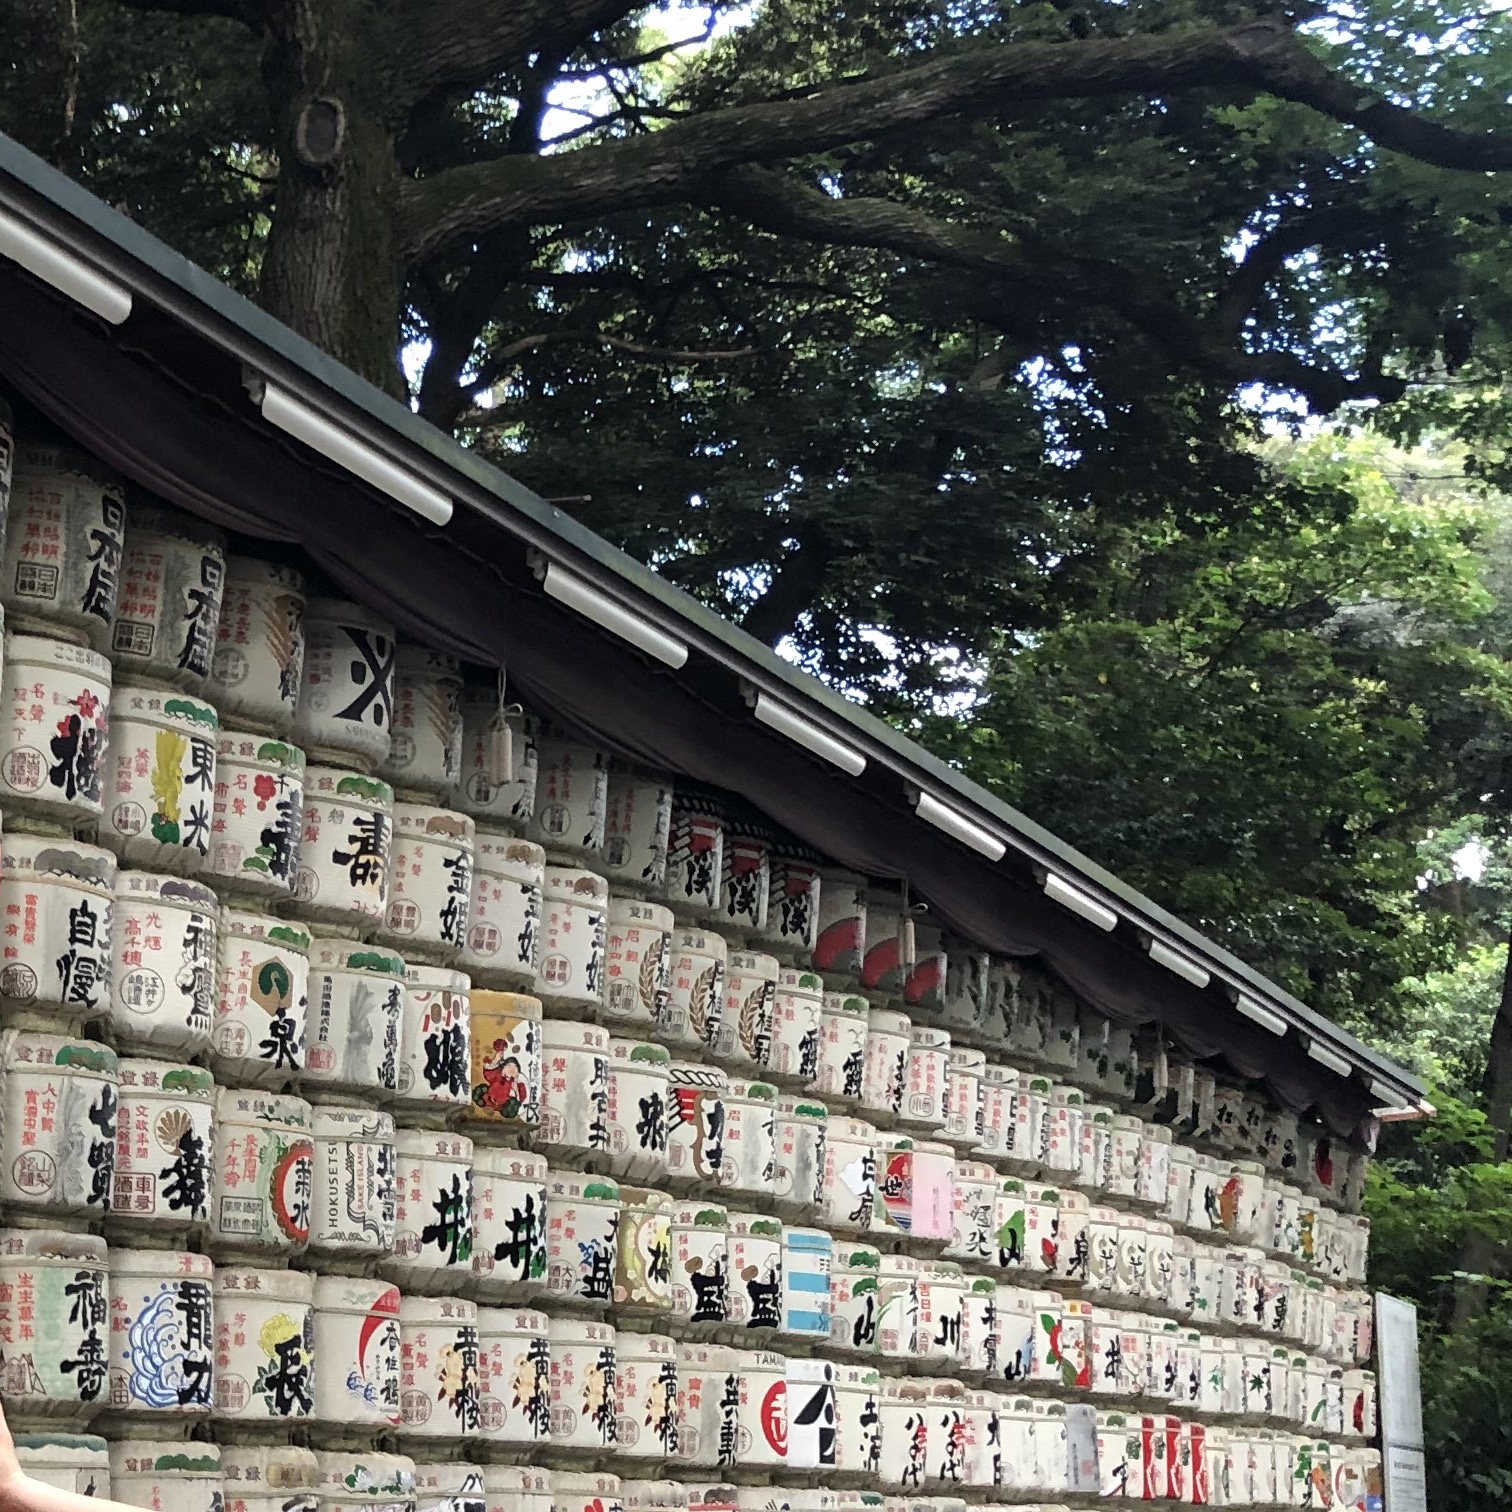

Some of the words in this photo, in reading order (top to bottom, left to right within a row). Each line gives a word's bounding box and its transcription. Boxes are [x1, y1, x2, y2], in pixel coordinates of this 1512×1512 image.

[259, 1007, 300, 1072] 泉
[290, 1157, 313, 1232] 菊水
[60, 1271, 109, 1401] 福寿
